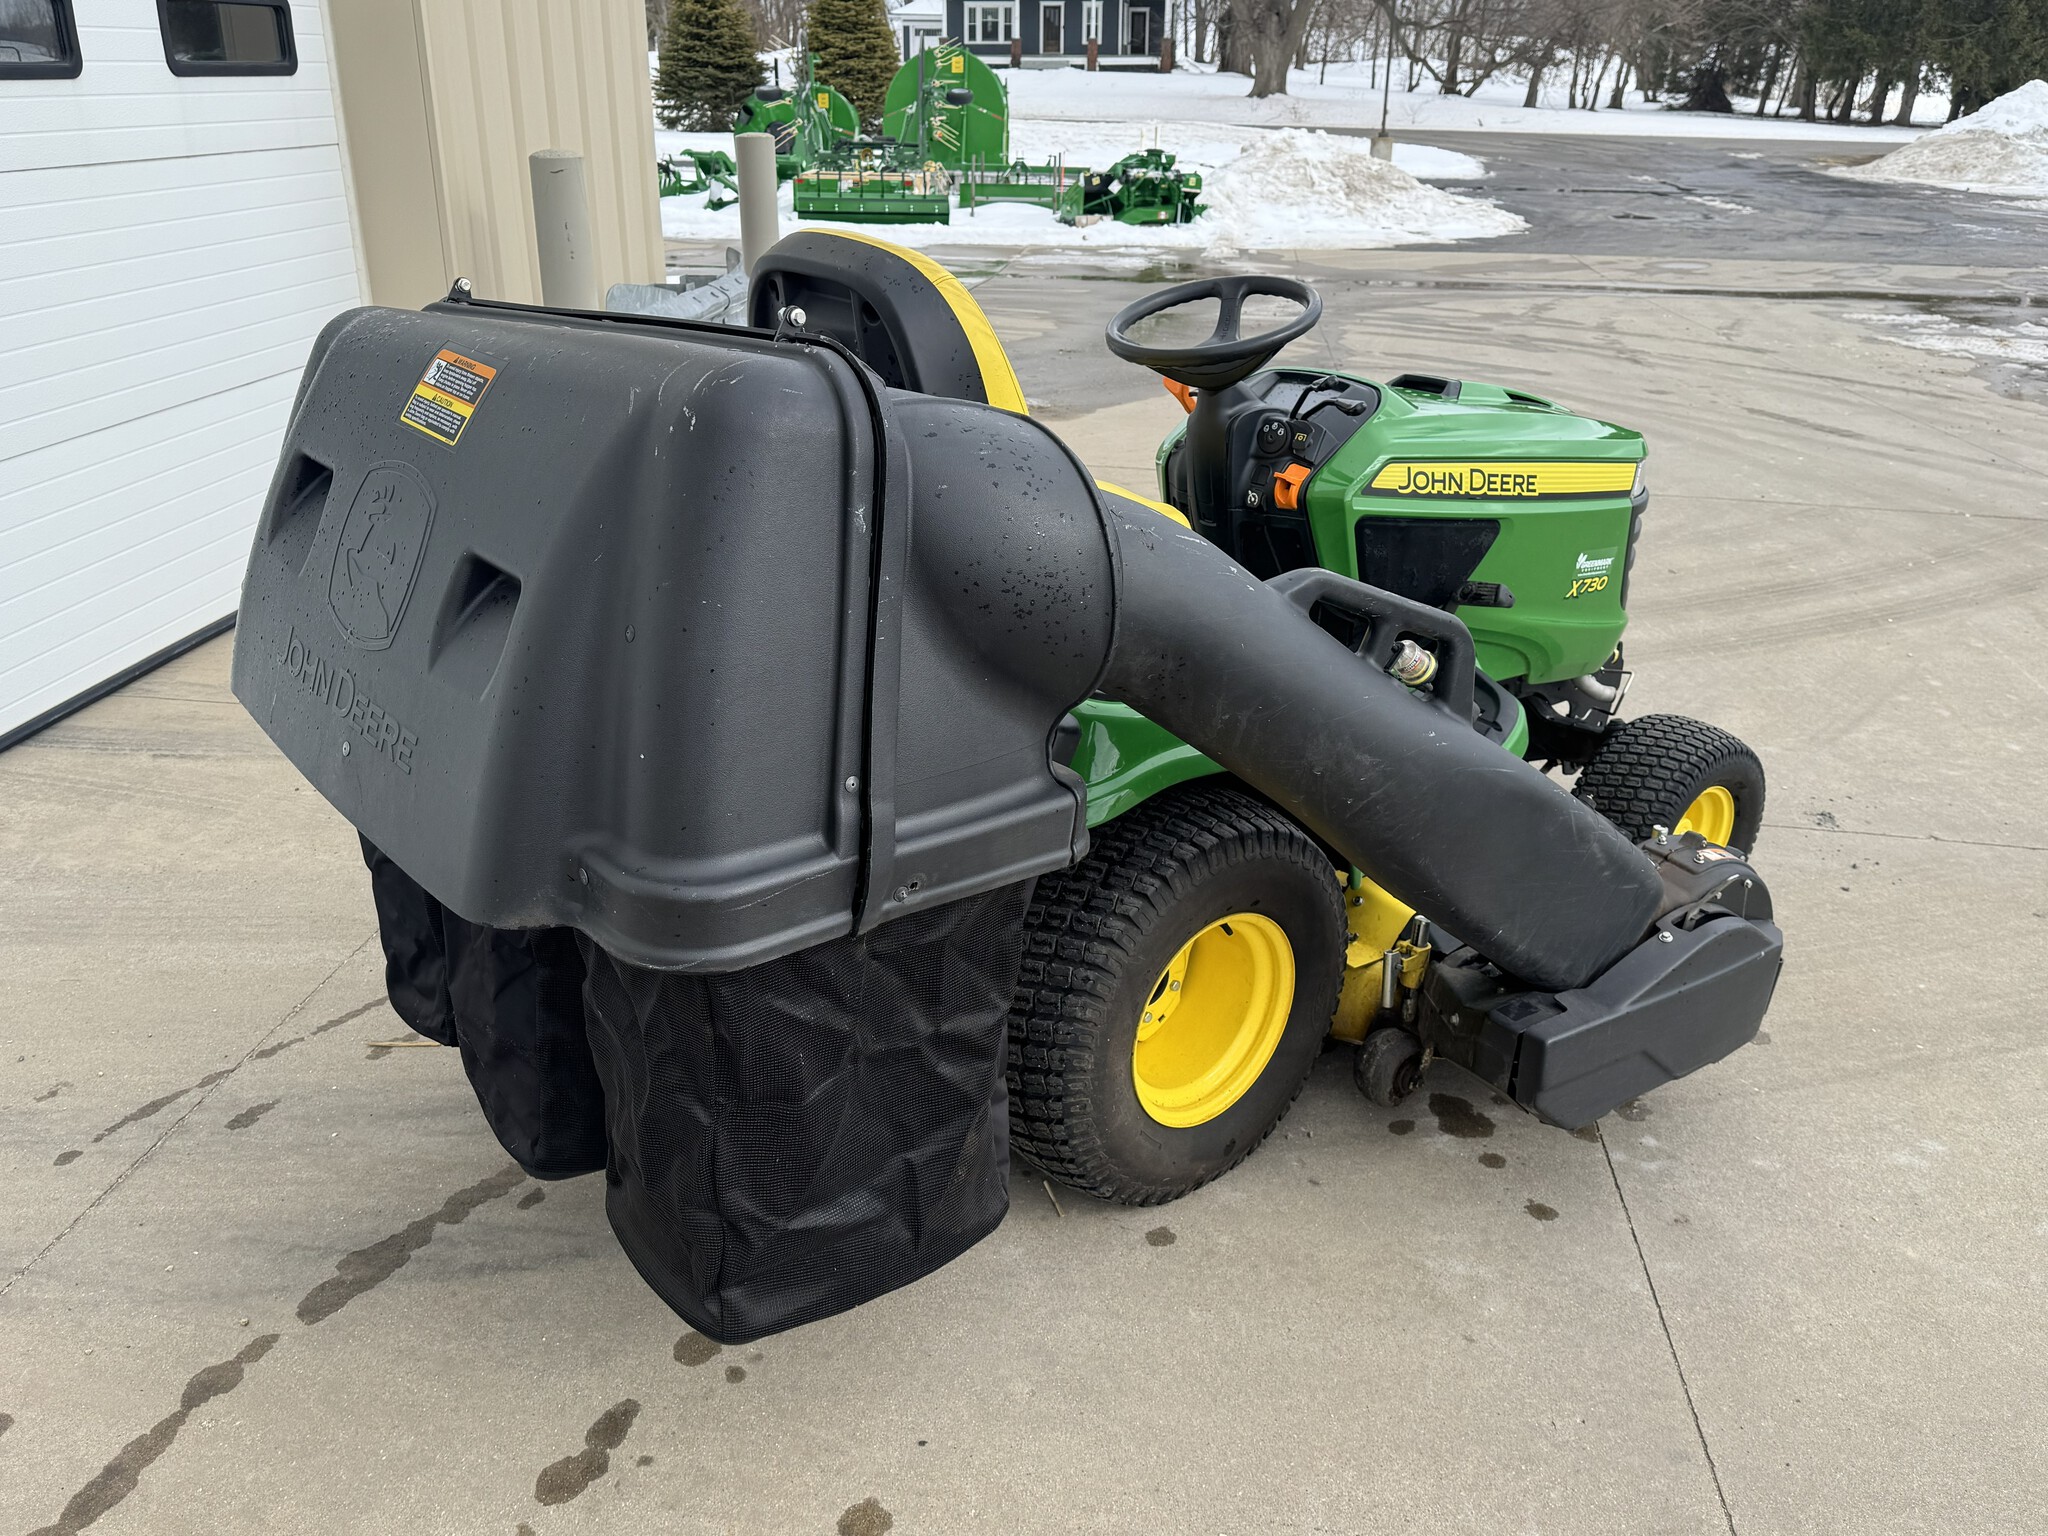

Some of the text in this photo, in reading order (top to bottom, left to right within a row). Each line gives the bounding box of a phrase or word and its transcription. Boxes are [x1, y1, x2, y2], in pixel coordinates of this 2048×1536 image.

[457, 357, 477, 370] WARNING
[437, 395, 454, 408] CAUTION
[1398, 466, 1538, 493] JOHN DEERE
[1565, 575, 1609, 599] X730
[278, 625, 419, 775] JOHN DEERE
